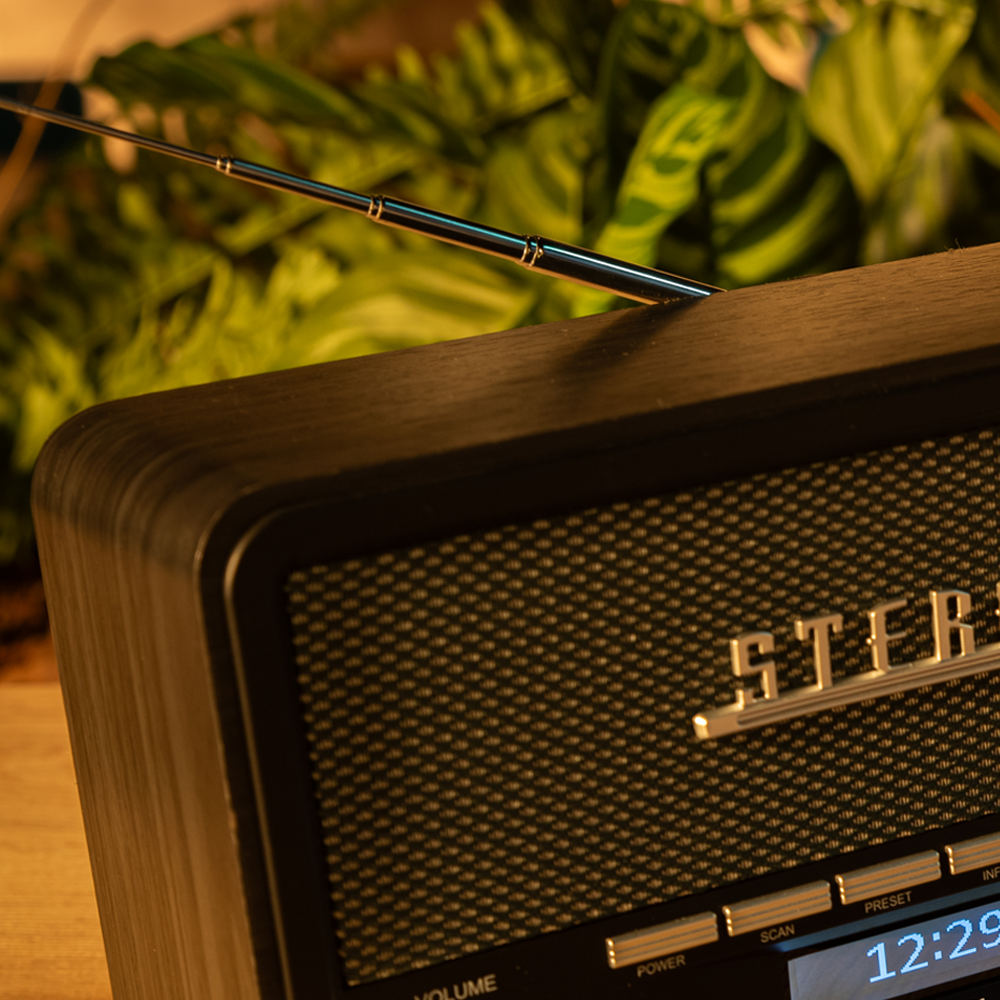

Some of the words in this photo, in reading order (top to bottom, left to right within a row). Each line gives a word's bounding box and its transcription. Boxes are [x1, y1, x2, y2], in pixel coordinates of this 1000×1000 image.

[864, 891, 913, 914] PRESET
[760, 924, 796, 944] SCAN
[636, 955, 686, 978] POWER
